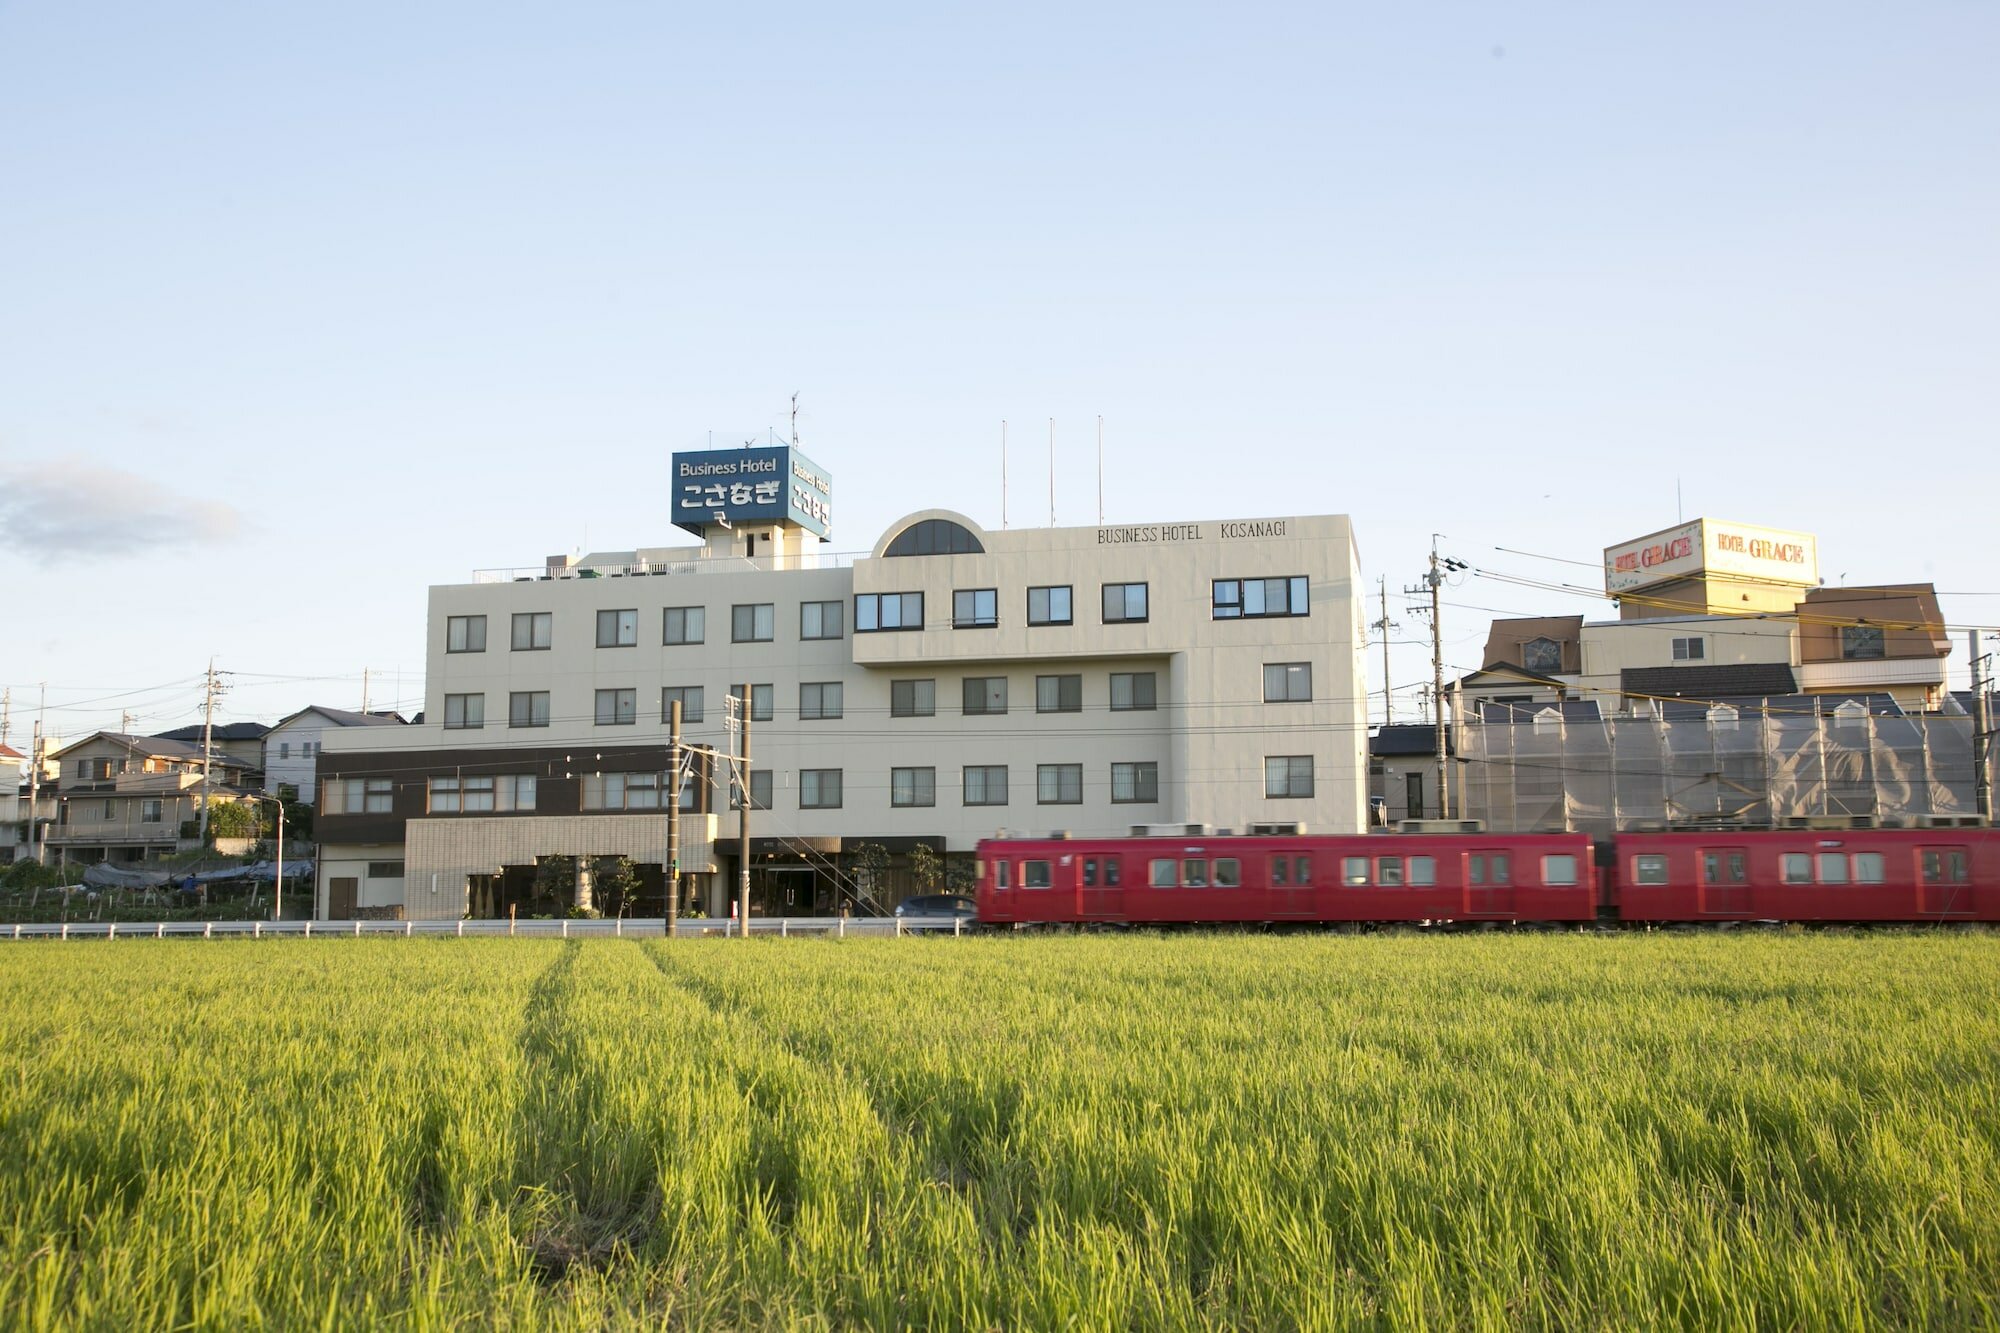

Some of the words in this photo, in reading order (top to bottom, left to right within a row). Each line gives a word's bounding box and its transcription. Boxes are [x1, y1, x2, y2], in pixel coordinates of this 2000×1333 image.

[680, 462, 737, 477] Business
[740, 458, 776, 473] Hotel
[681, 480, 780, 507] こさなぎ
[1098, 527, 1157, 544] BUSINESS
[1162, 525, 1203, 541] HOTEL
[1221, 521, 1286, 539] KOSANAGI
[1615, 552, 1640, 573] HOTEL
[1641, 537, 1692, 568] GRACE
[1717, 533, 1746, 553] HOTEL
[1749, 539, 1804, 564] GRACE
